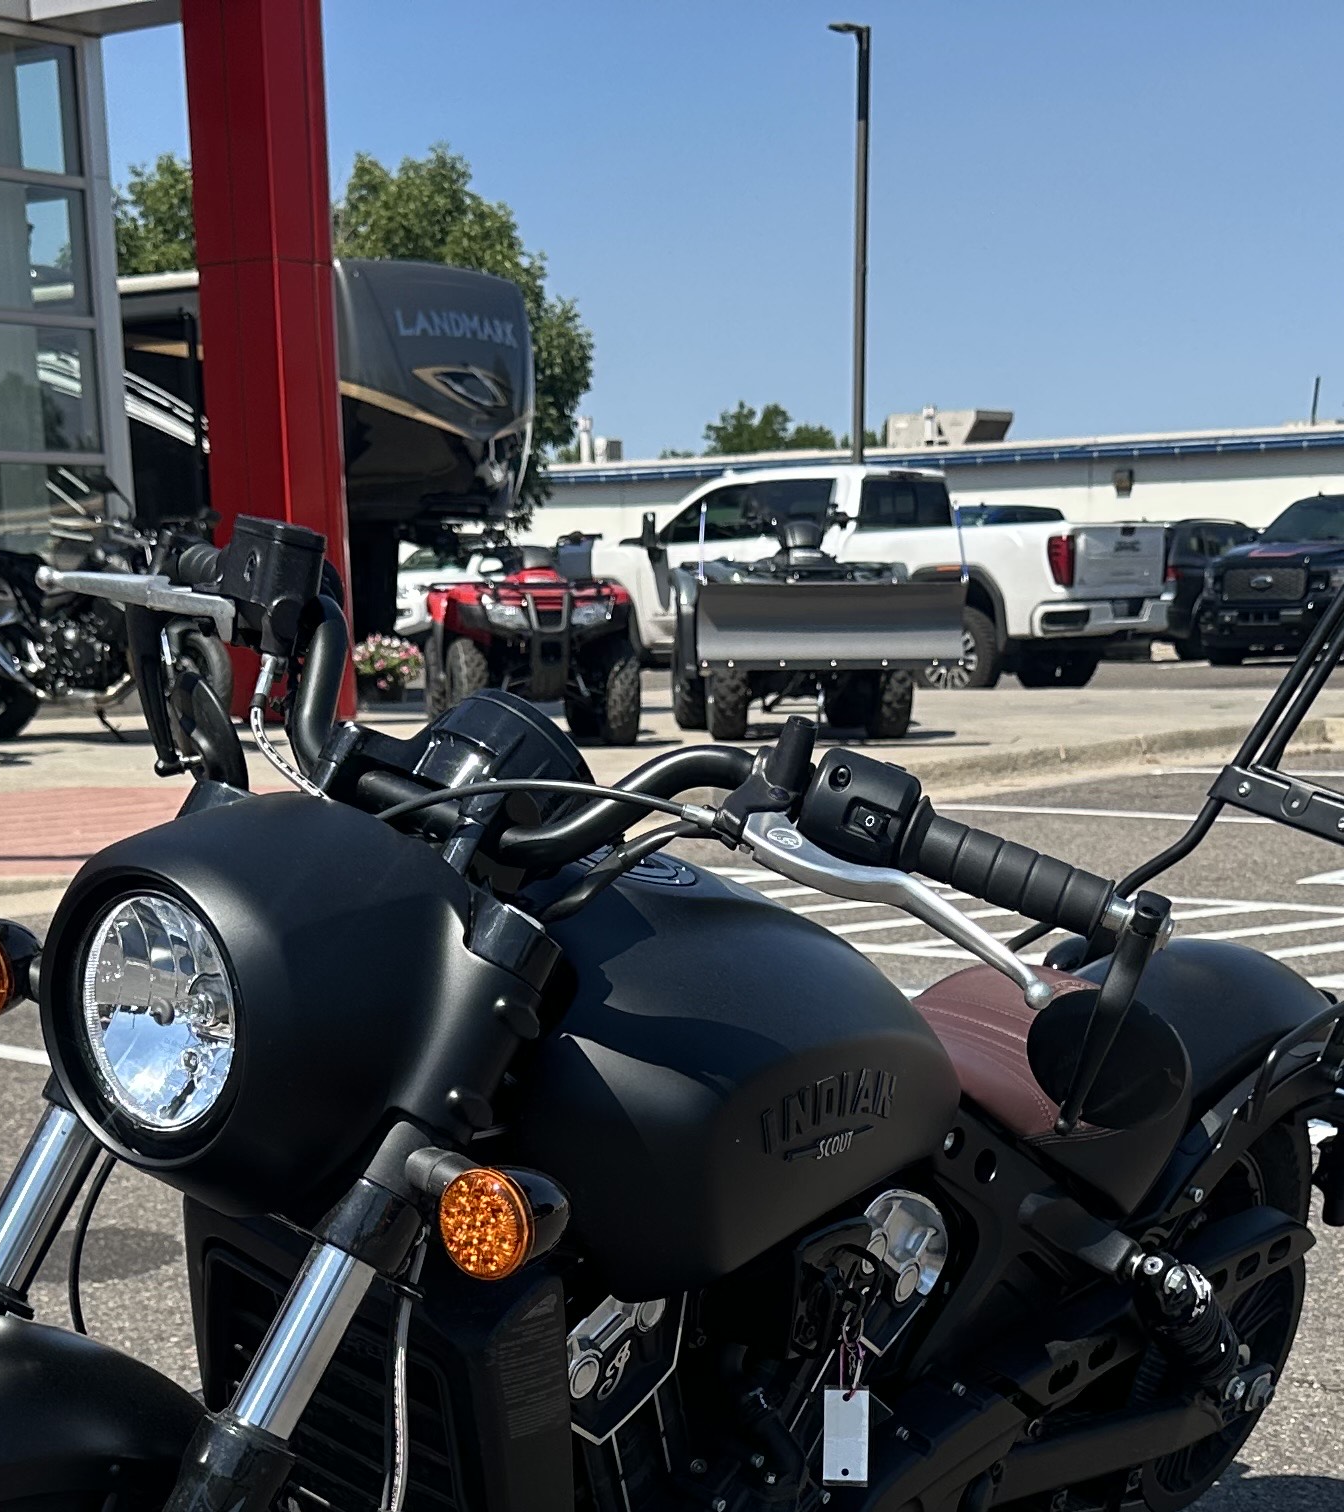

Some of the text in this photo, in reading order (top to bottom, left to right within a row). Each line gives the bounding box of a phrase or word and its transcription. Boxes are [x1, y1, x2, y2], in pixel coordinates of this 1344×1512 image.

[395, 309, 519, 349] LANDMARK
[761, 1068, 897, 1154] INDIAN
[816, 1130, 854, 1160] SCOUT
